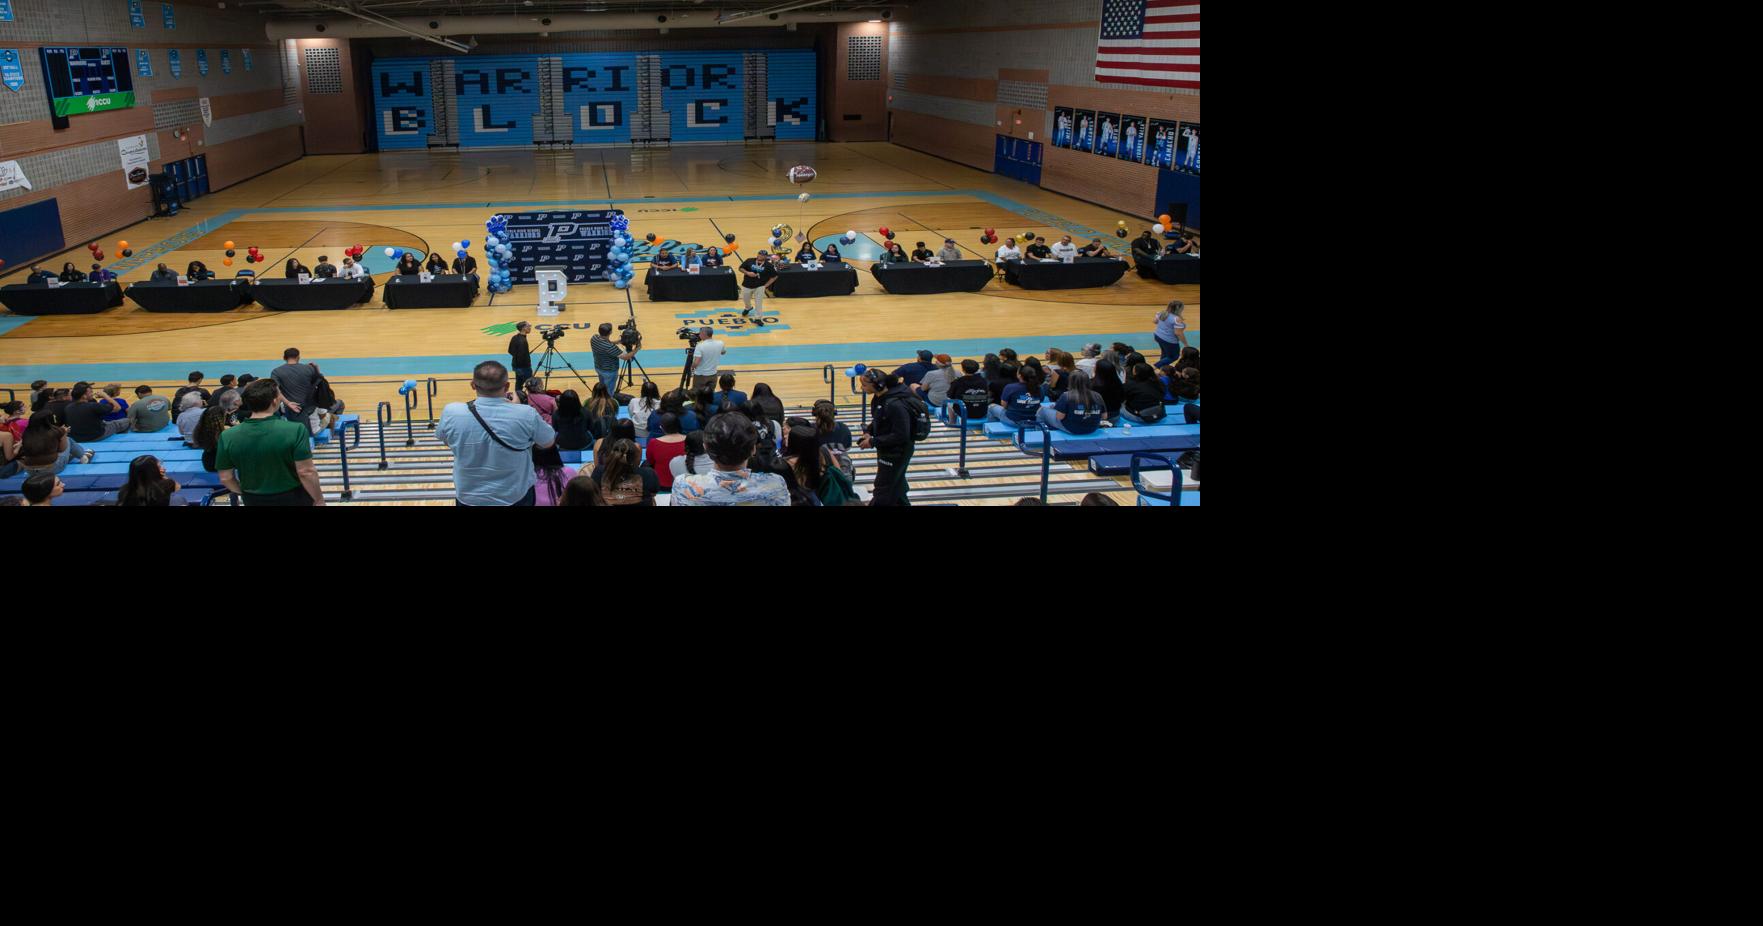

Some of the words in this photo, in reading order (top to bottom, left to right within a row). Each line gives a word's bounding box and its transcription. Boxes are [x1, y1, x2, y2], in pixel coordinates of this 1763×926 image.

[380, 63, 738, 98] WARRIOR
[383, 97, 809, 136] BLOCK
[1164, 130, 1175, 161] CAMACHO
[542, 222, 579, 242] P
[535, 269, 568, 316] P
